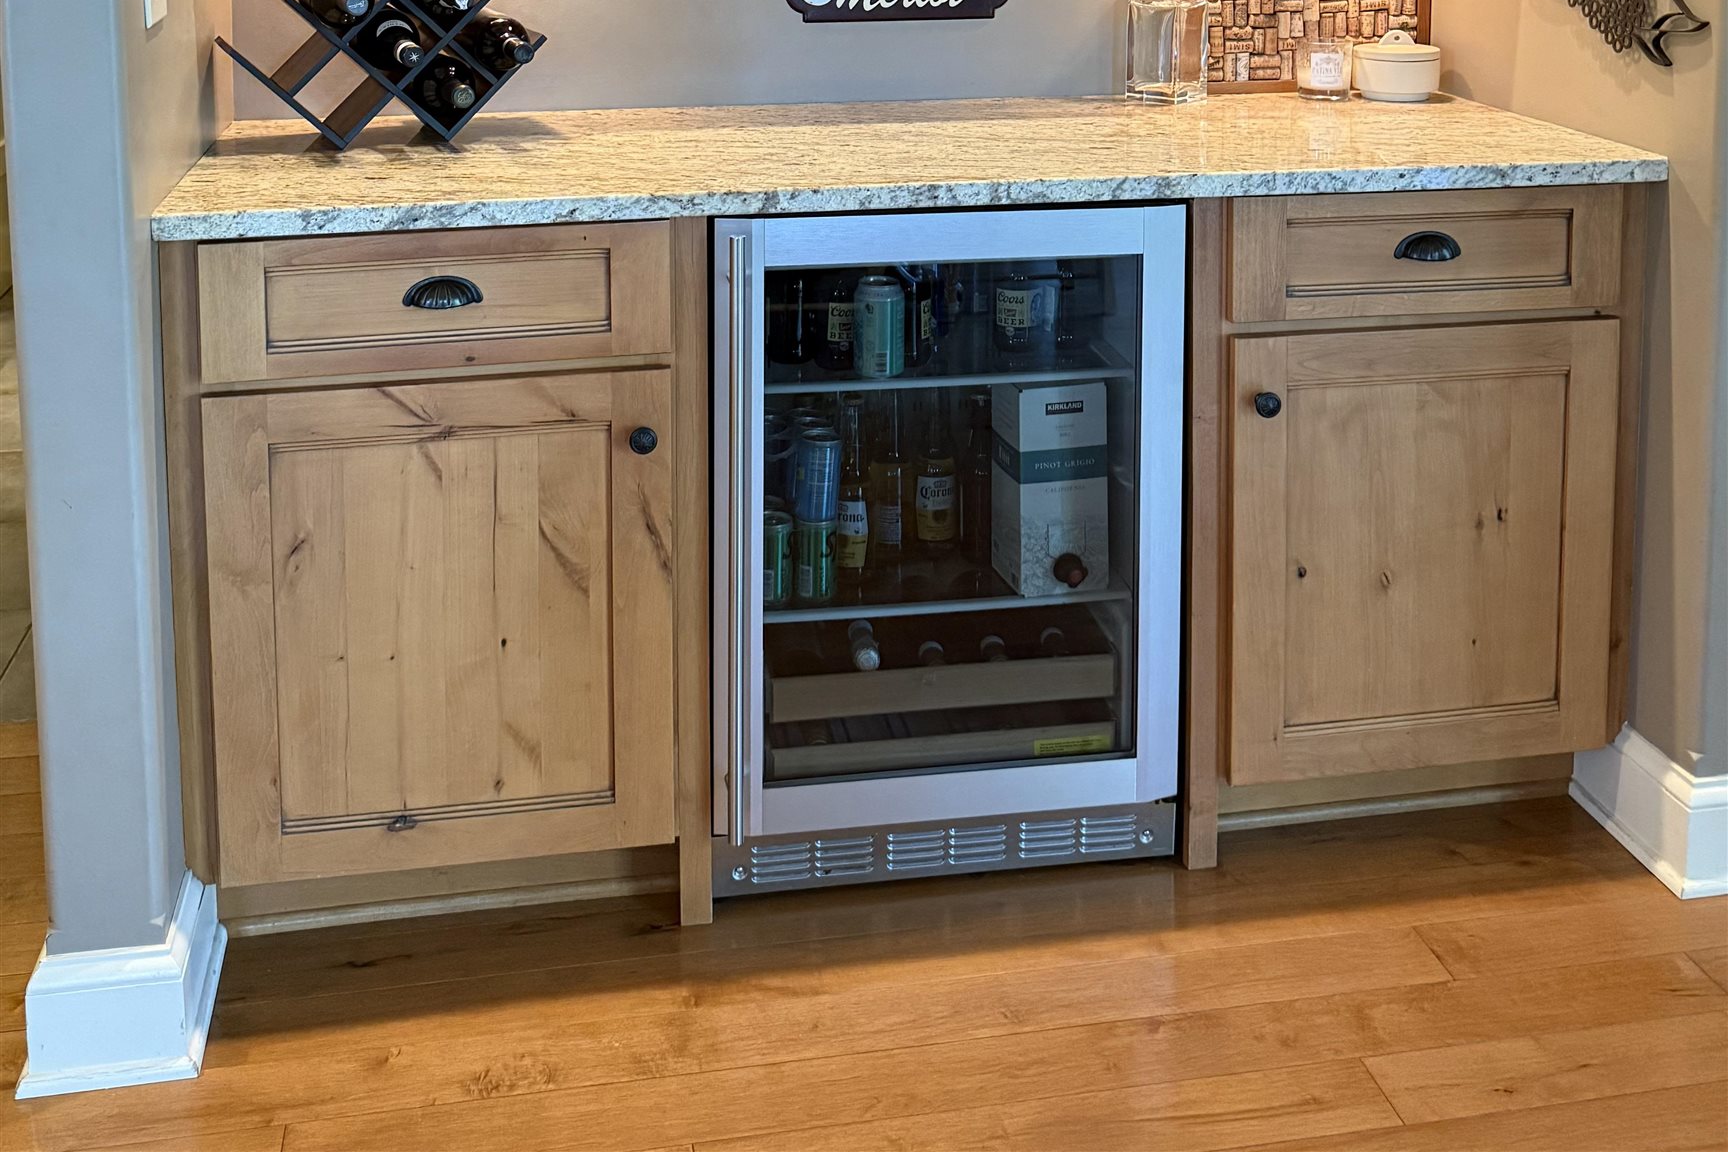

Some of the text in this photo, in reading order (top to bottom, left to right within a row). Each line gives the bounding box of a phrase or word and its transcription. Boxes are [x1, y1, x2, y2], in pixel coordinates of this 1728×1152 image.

[1229, 43, 1251, 51] SIMI
[997, 291, 1025, 305] Coors
[997, 316, 1025, 326] BEER
[829, 331, 853, 340] BEE
[1047, 401, 1082, 411] KIRKLAND
[1034, 458, 1096, 470] PINOT GRIGIO
[920, 485, 953, 501] Coron
[838, 512, 865, 523] rona
